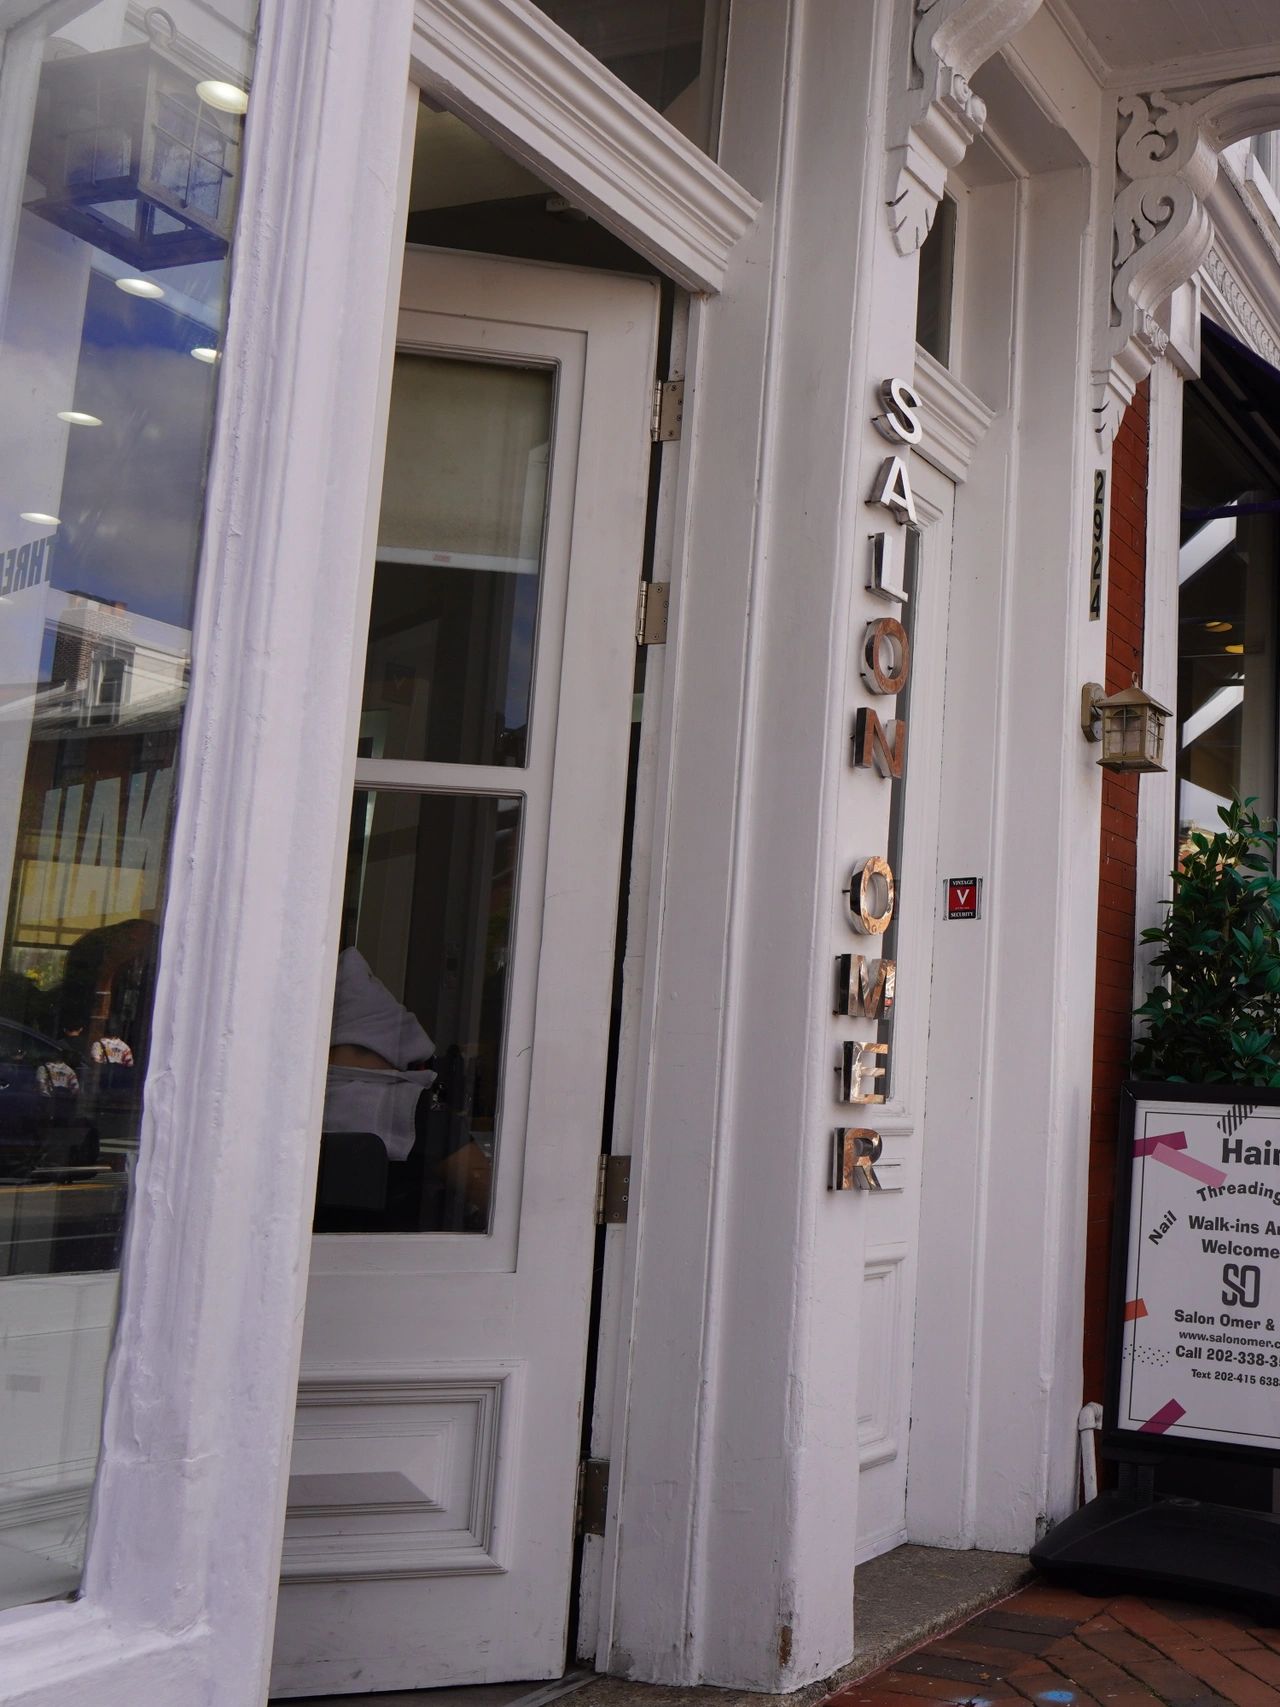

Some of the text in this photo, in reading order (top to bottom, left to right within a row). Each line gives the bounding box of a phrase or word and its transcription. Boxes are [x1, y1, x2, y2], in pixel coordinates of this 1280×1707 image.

[1090, 471, 1104, 618] 2924
[854, 377, 923, 779] SALON
[956, 889, 970, 905] V
[833, 856, 896, 1191] OMER
[1148, 1210, 1177, 1246] Nail
[1188, 1215, 1260, 1236] Walk-ins
[1201, 1239, 1280, 1260] Welcome
[1221, 1263, 1261, 1308] SO
[1174, 1309, 1216, 1327] Salon
[1219, 1313, 1262, 1331] Omer
[1265, 1318, 1276, 1332] &
[1175, 1345, 1203, 1360] Call
[1191, 1368, 1212, 1381] Text
[1214, 1371, 1257, 1386] 202-415
